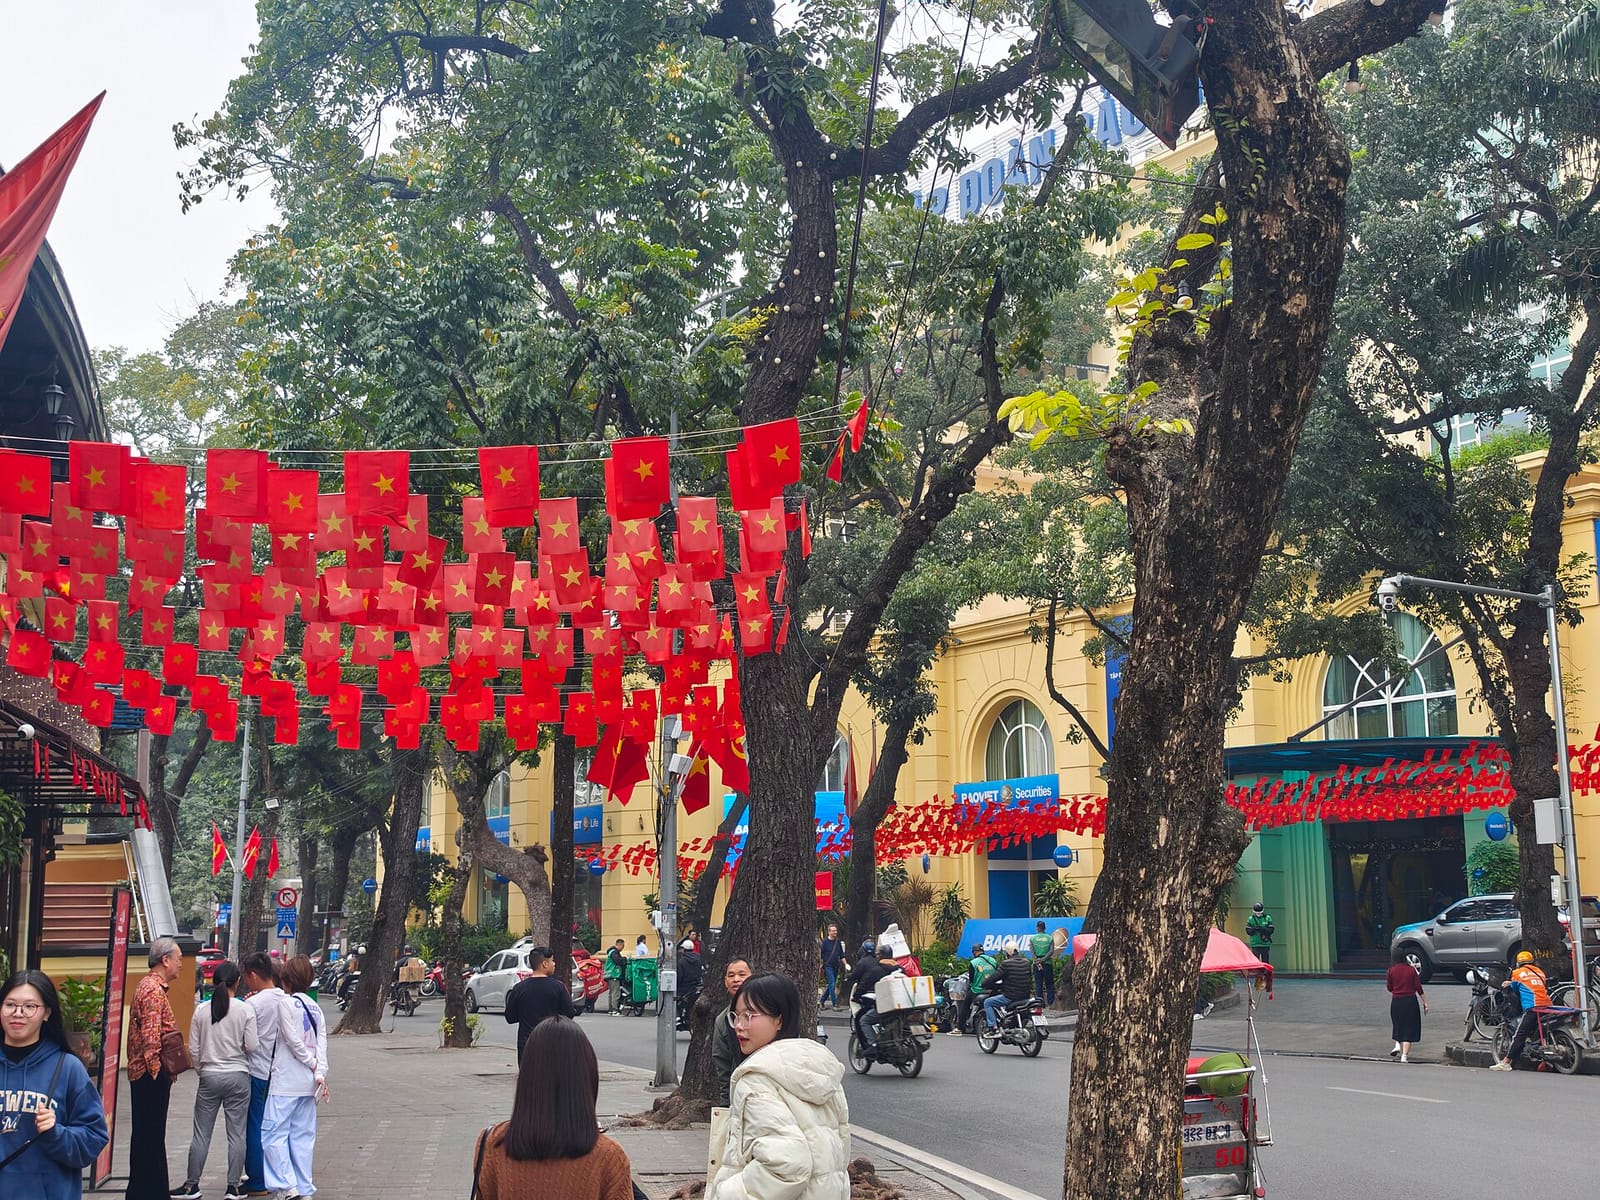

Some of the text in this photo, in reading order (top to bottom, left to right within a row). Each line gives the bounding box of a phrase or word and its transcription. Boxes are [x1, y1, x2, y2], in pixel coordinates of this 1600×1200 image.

[1015, 785, 1052, 799] Securities
[983, 934, 1035, 951] BAOVIE
[1215, 1146, 1245, 1168] 50
